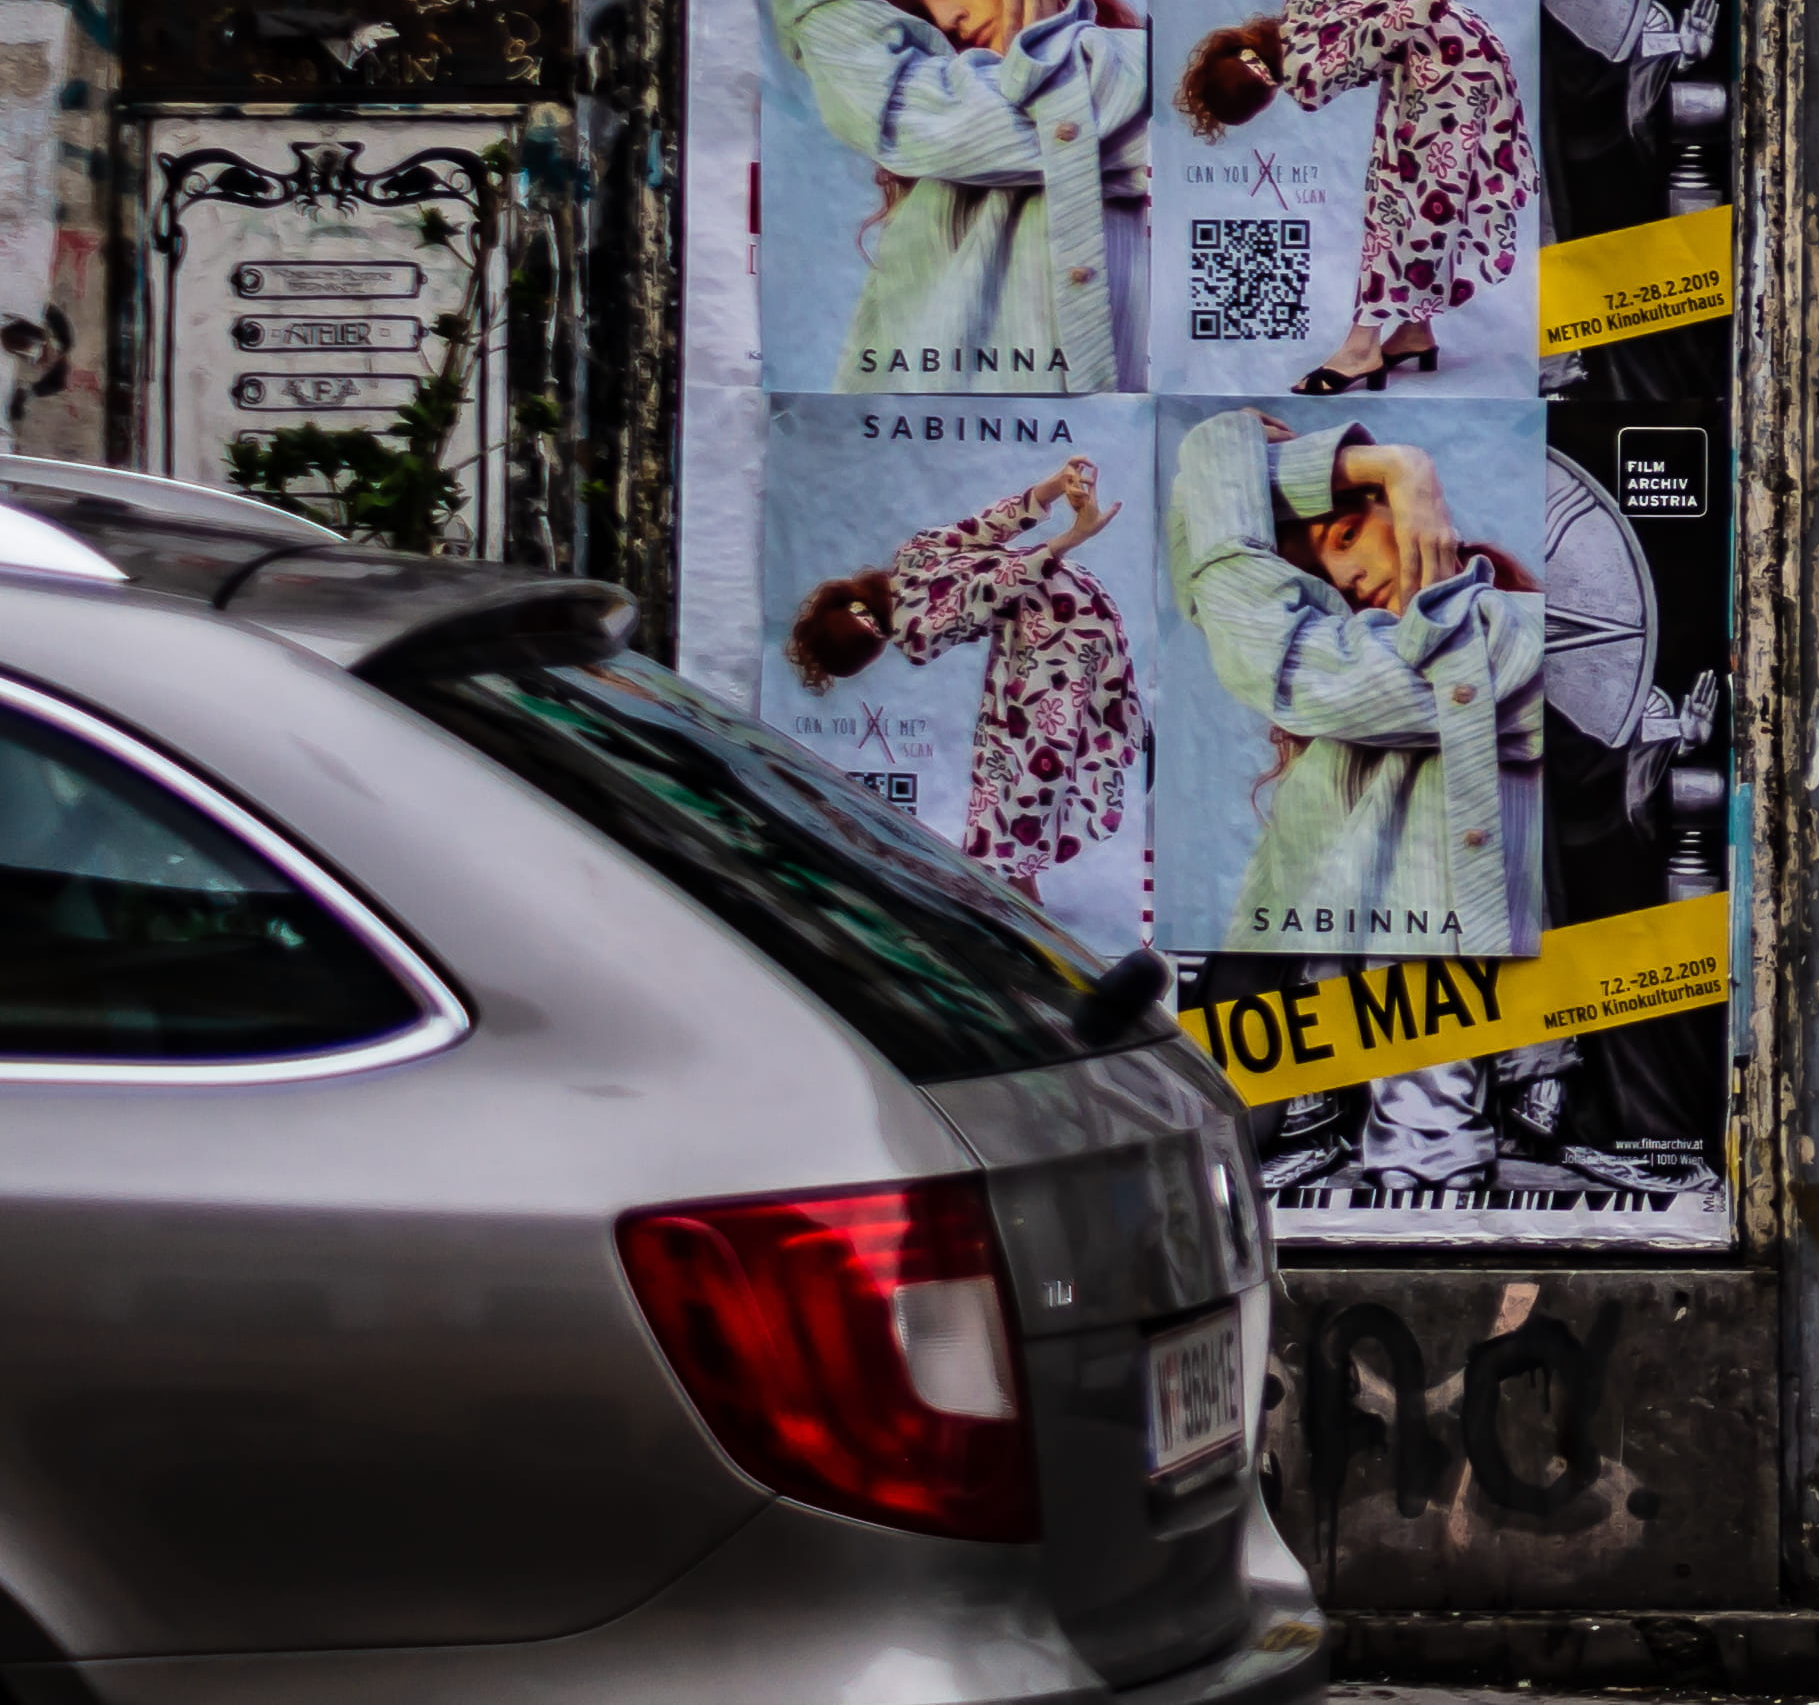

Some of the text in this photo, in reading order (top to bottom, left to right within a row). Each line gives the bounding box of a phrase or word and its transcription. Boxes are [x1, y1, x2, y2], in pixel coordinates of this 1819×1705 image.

[1187, 165, 1214, 183] CAN
[1224, 165, 1249, 182] YOU
[1295, 188, 1326, 203] SCAN
[1603, 270, 1721, 311] 7.2.-28.2.2019
[1546, 291, 1725, 345] METRO Kinokulturhaus
[859, 348, 1070, 373] SABINNA
[863, 414, 1074, 444] SABINNA
[1627, 461, 1665, 473] FILM
[1627, 478, 1688, 490] ARCHIV
[1627, 495, 1698, 508] AUSTRIA
[794, 716, 823, 735] CAN
[832, 717, 857, 735] YOU
[902, 742, 934, 758] SCAN
[1253, 907, 1464, 936] SABINNA
[1600, 956, 1717, 998] 7.2.-28.2.2019
[1202, 957, 1505, 1074] JOE MAY
[1543, 977, 1722, 1031] METRO Kinokulturhaus
